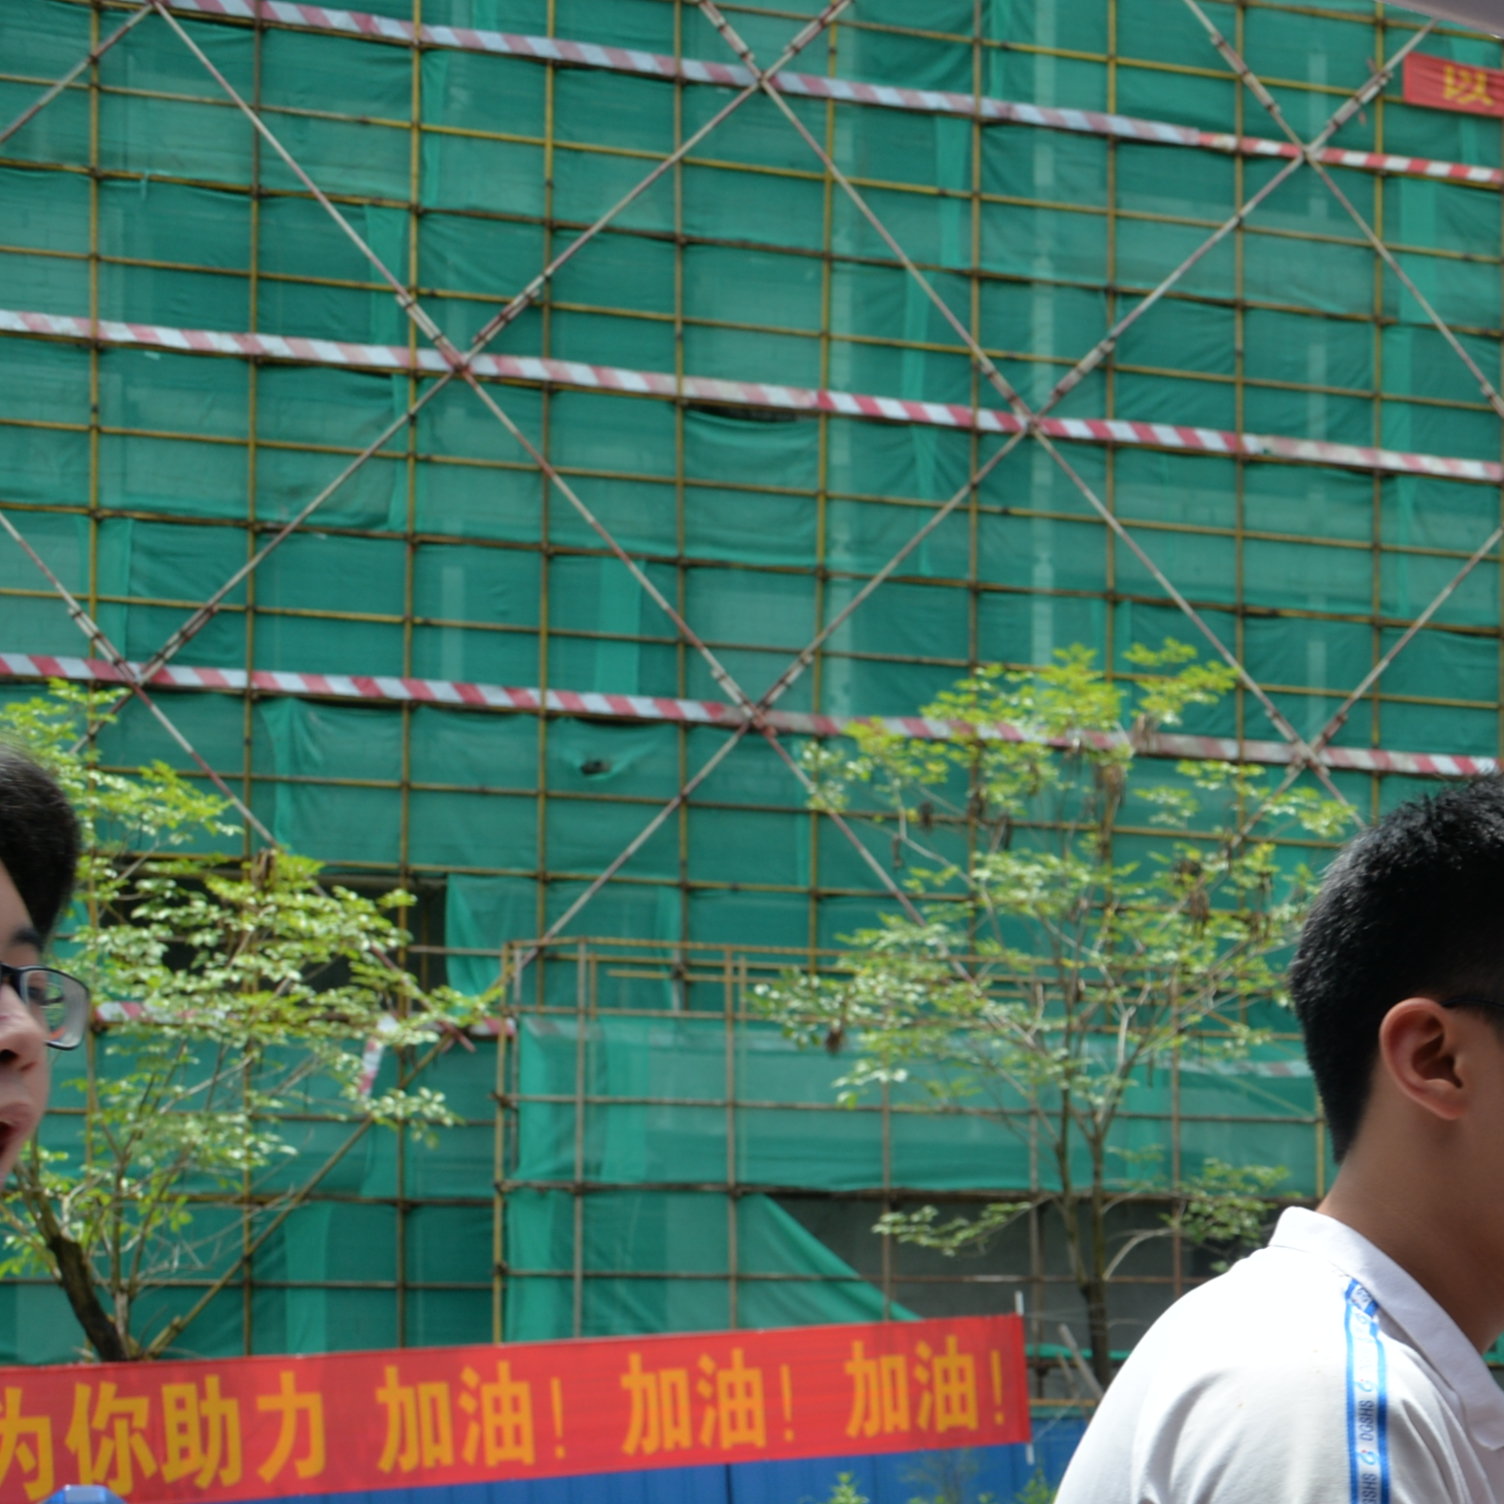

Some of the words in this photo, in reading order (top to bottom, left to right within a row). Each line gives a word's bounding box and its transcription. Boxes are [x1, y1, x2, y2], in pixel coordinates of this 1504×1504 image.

[0, 1371, 326, 1501] 为你助力
[376, 1361, 565, 1475] 加油！
[620, 1347, 793, 1455] 加油！
[845, 1334, 1004, 1439] 加油！
[1358, 1400, 1376, 1442] DGSHS
